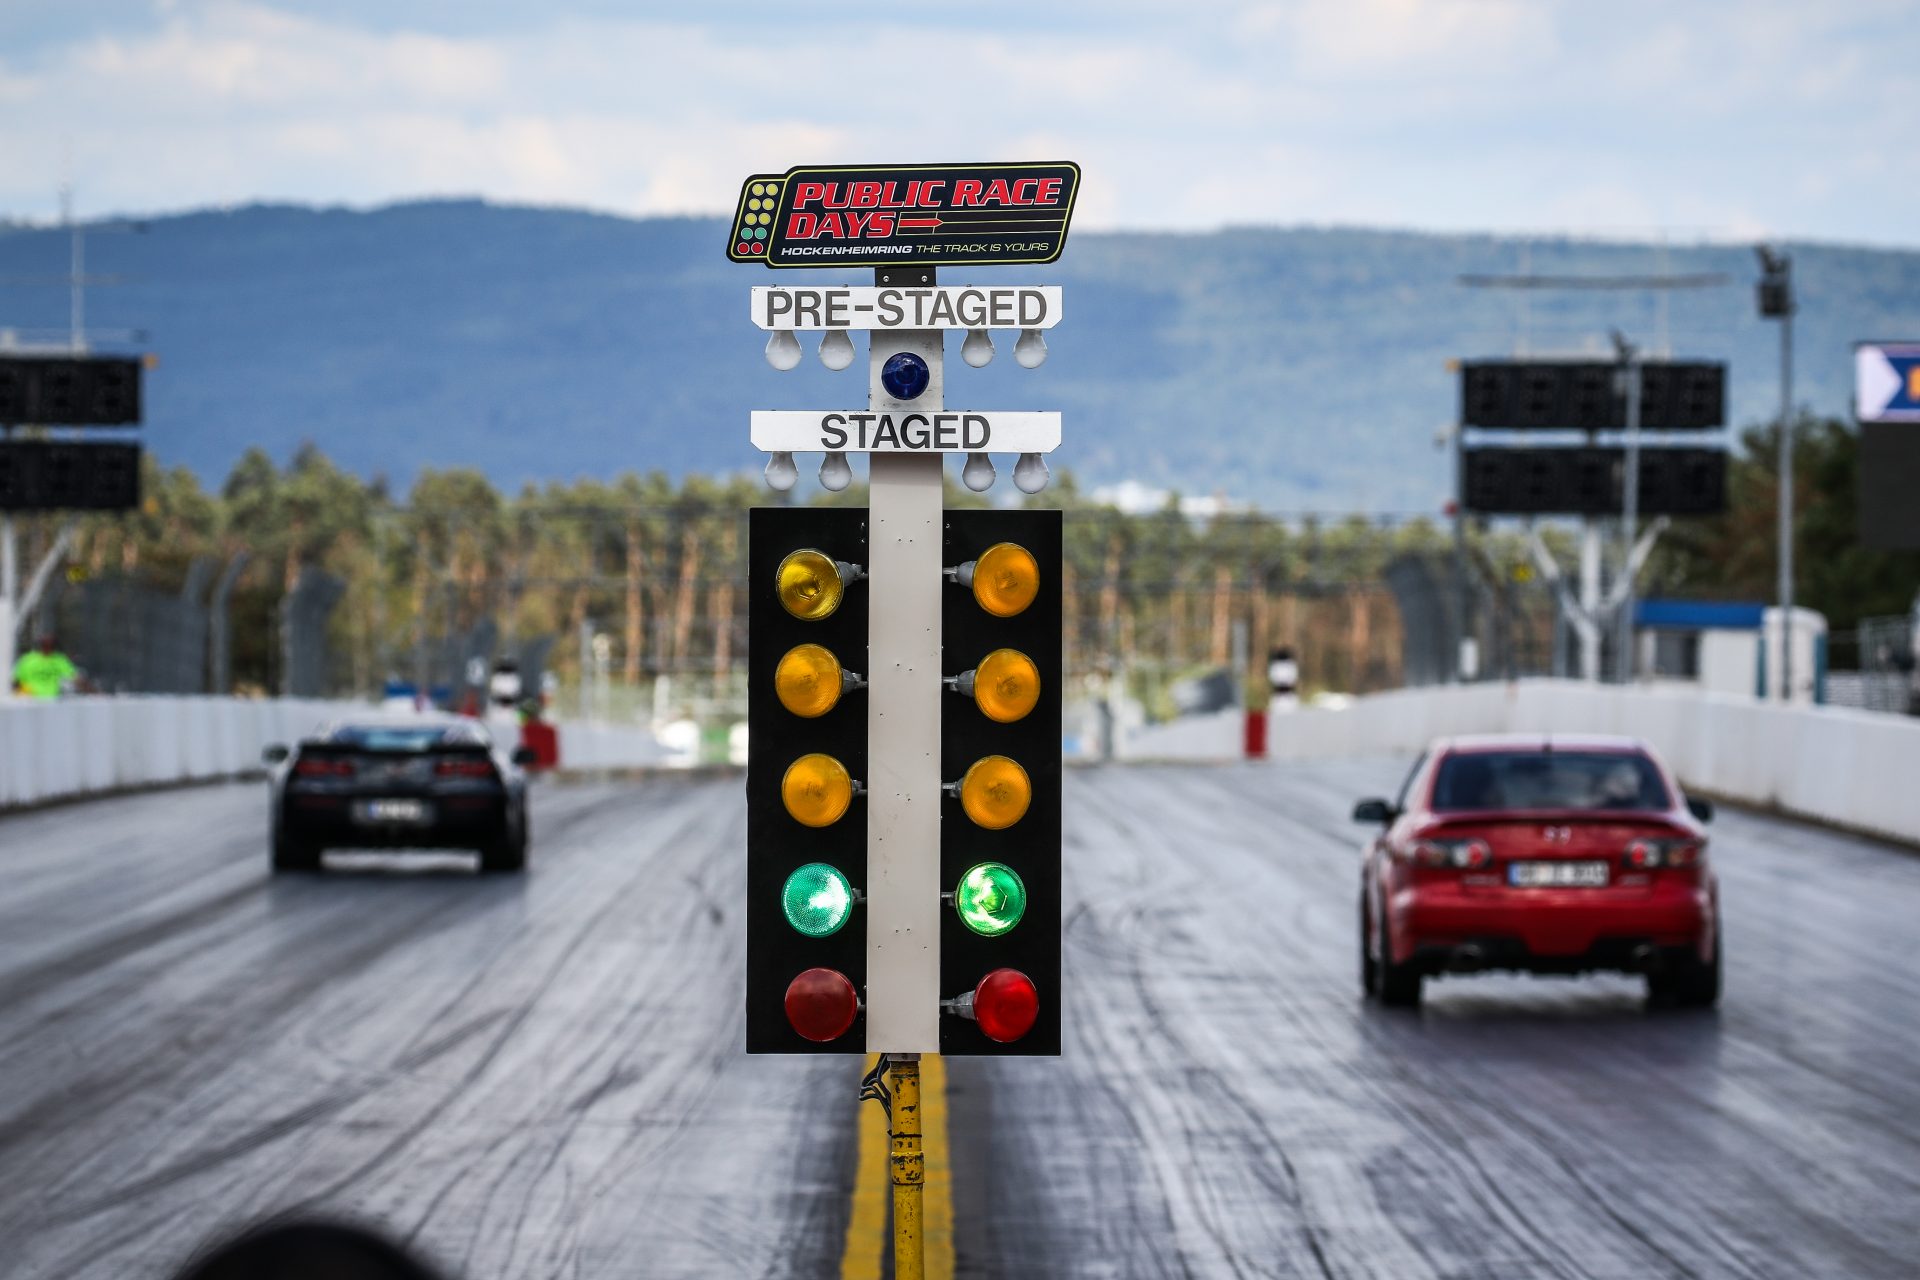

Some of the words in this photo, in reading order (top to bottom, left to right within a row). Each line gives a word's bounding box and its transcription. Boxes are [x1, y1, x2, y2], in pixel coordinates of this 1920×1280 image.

[793, 181, 945, 209] PUBLIC
[951, 178, 1063, 207] RACE
[785, 211, 897, 240] DAYS
[780, 245, 913, 256] HOCKENHEIMRING
[916, 244, 942, 254] THE
[944, 243, 987, 253] TRACK
[989, 243, 1002, 252] IS
[1004, 242, 1049, 252] YOURS
[766, 289, 1048, 327] PRE-STAGED
[820, 413, 991, 449] STAGED
